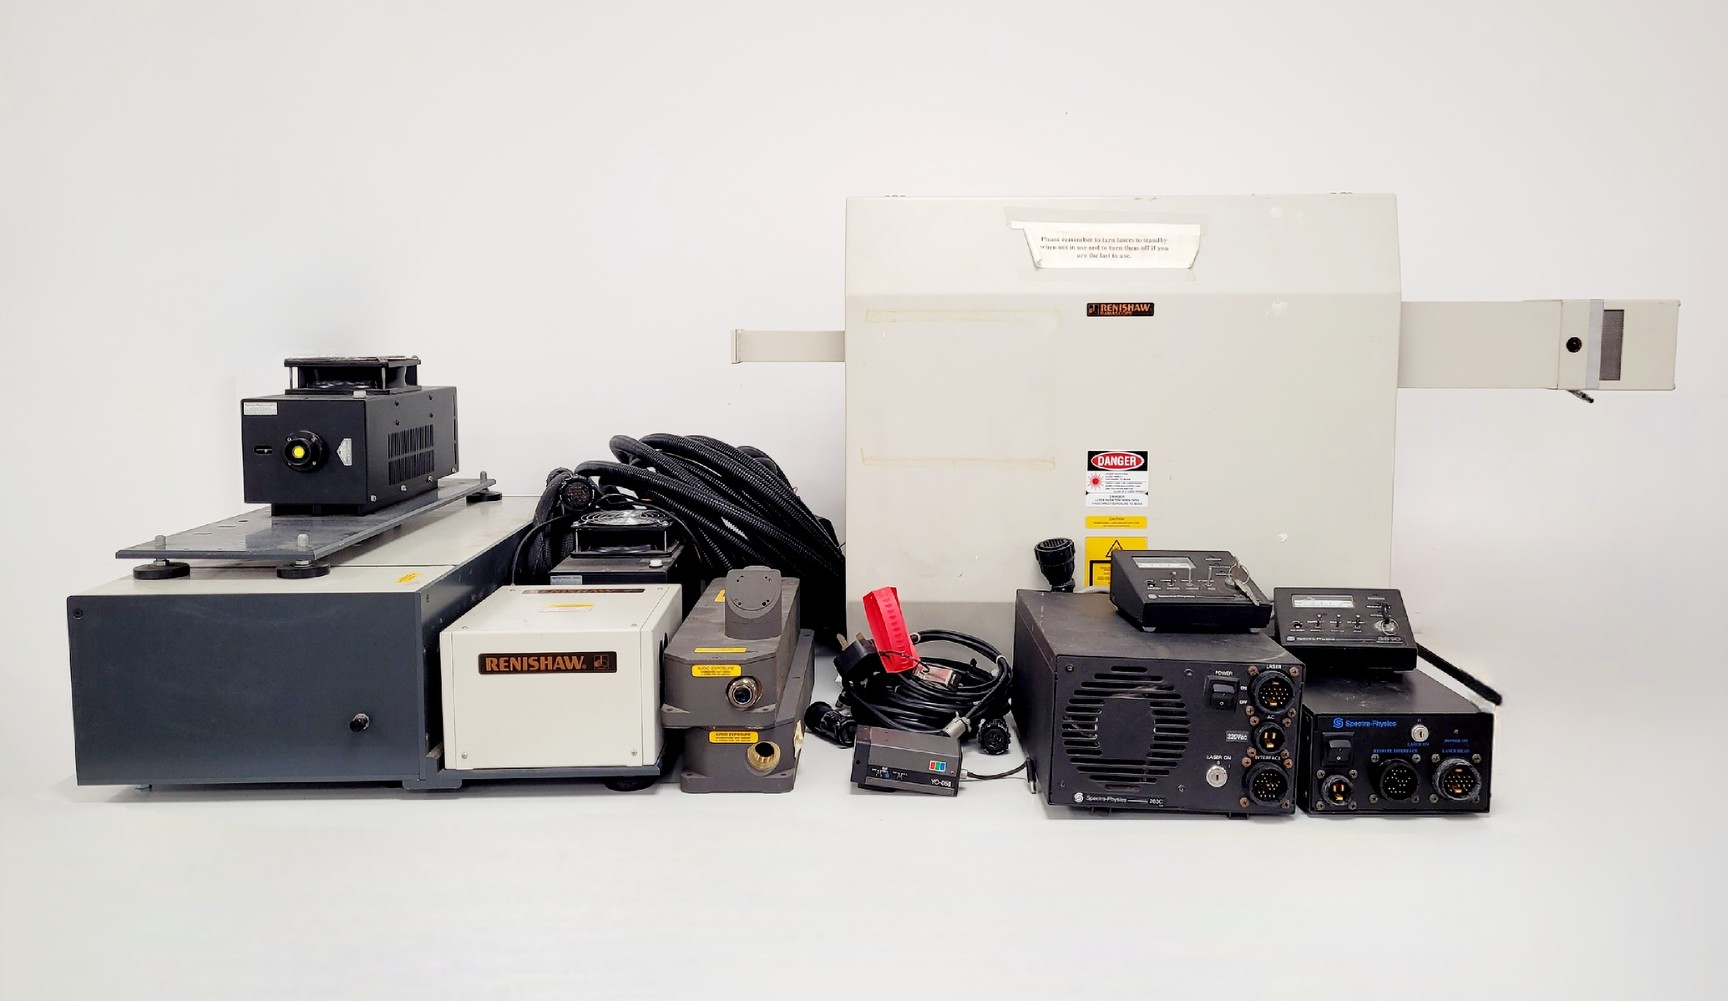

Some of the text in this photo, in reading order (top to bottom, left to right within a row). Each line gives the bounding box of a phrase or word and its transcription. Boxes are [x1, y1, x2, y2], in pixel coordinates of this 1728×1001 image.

[1098, 456, 1136, 466] DANGER
[486, 656, 584, 671] RENISHAW
[1086, 795, 1127, 803] Spectra-Physics
